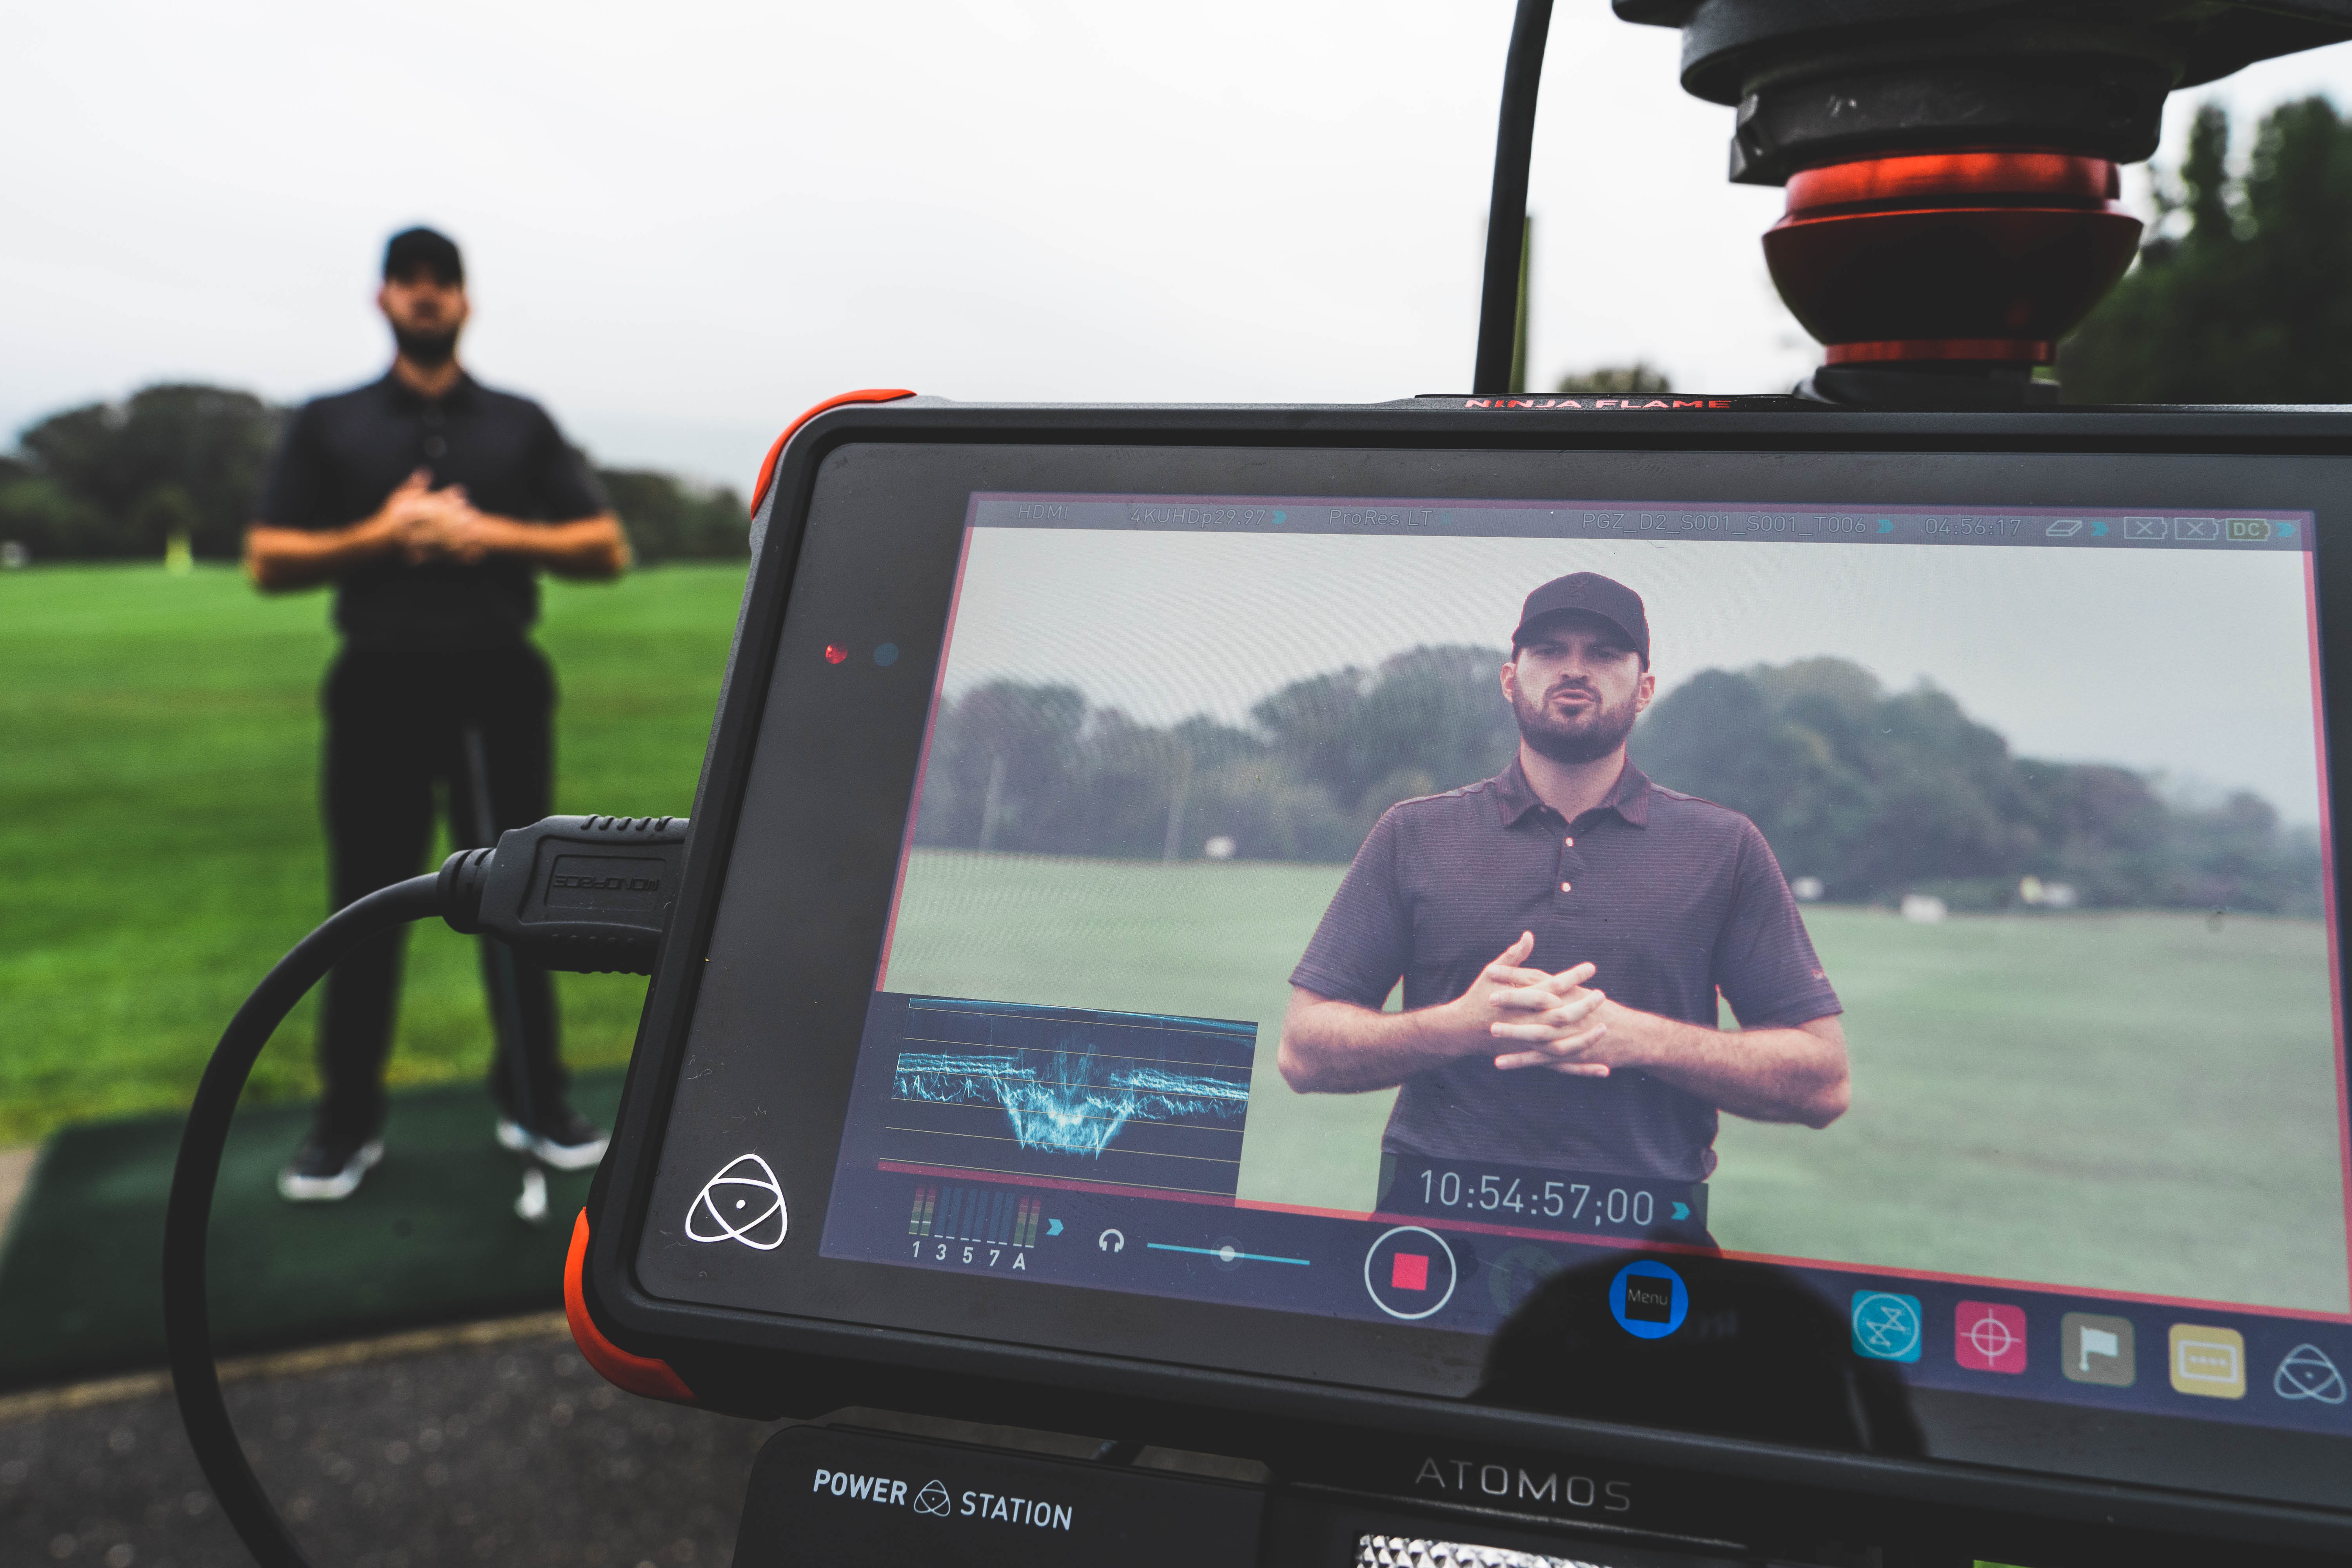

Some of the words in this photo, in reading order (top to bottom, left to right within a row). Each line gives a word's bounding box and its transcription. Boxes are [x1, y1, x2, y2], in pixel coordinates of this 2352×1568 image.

[1465, 400, 1581, 408] NINJA
[1595, 400, 1731, 408] FLAME
[1018, 504, 1069, 520] HDMI
[1130, 507, 1266, 528] 4KUHDp29.97
[1328, 509, 1400, 526] ProRes
[1408, 511, 1432, 526] LT
[1924, 518, 2022, 536] 04:56:17
[2233, 523, 2261, 536] DC
[1421, 1169, 1653, 1227] 10:54:57;00
[913, 1241, 920, 1257] 1
[936, 1244, 946, 1260] 3
[962, 1247, 973, 1263] 5
[989, 1249, 1000, 1267] 7
[1013, 1252, 1025, 1270] A
[1627, 1289, 1668, 1306] Menu
[1416, 1457, 1631, 1511] ATOMOS
[813, 1469, 907, 1505] POWER
[960, 1491, 1072, 1530] STATION
